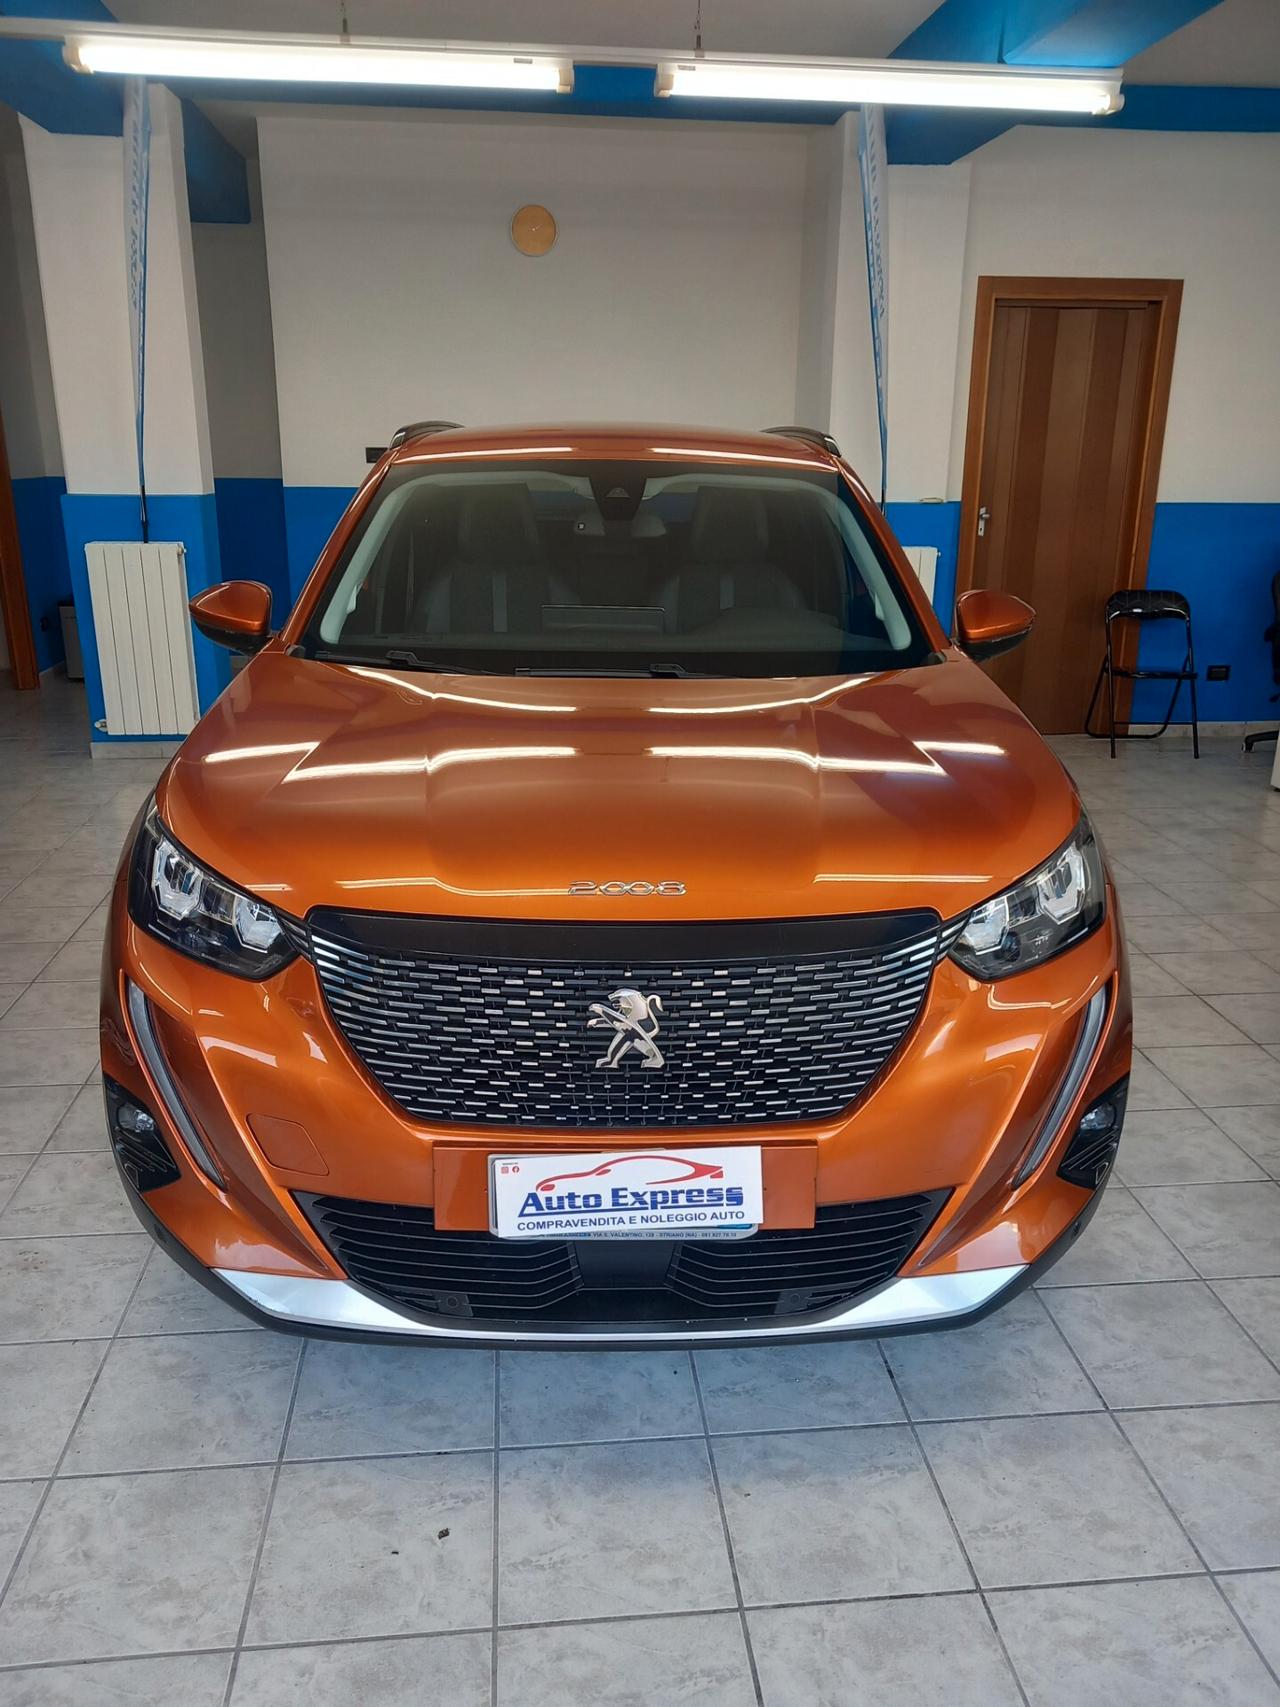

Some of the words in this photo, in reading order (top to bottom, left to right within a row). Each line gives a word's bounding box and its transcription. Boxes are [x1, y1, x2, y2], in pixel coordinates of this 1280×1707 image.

[568, 880, 687, 896] 2008
[518, 1192, 602, 1217] Auto
[611, 1187, 743, 1210] Express
[517, 1216, 626, 1232] COMPRAVENDITA
[629, 1216, 637, 1224] E
[640, 1212, 708, 1224] NOLEGGIO
[710, 1211, 745, 1220] AUTO
